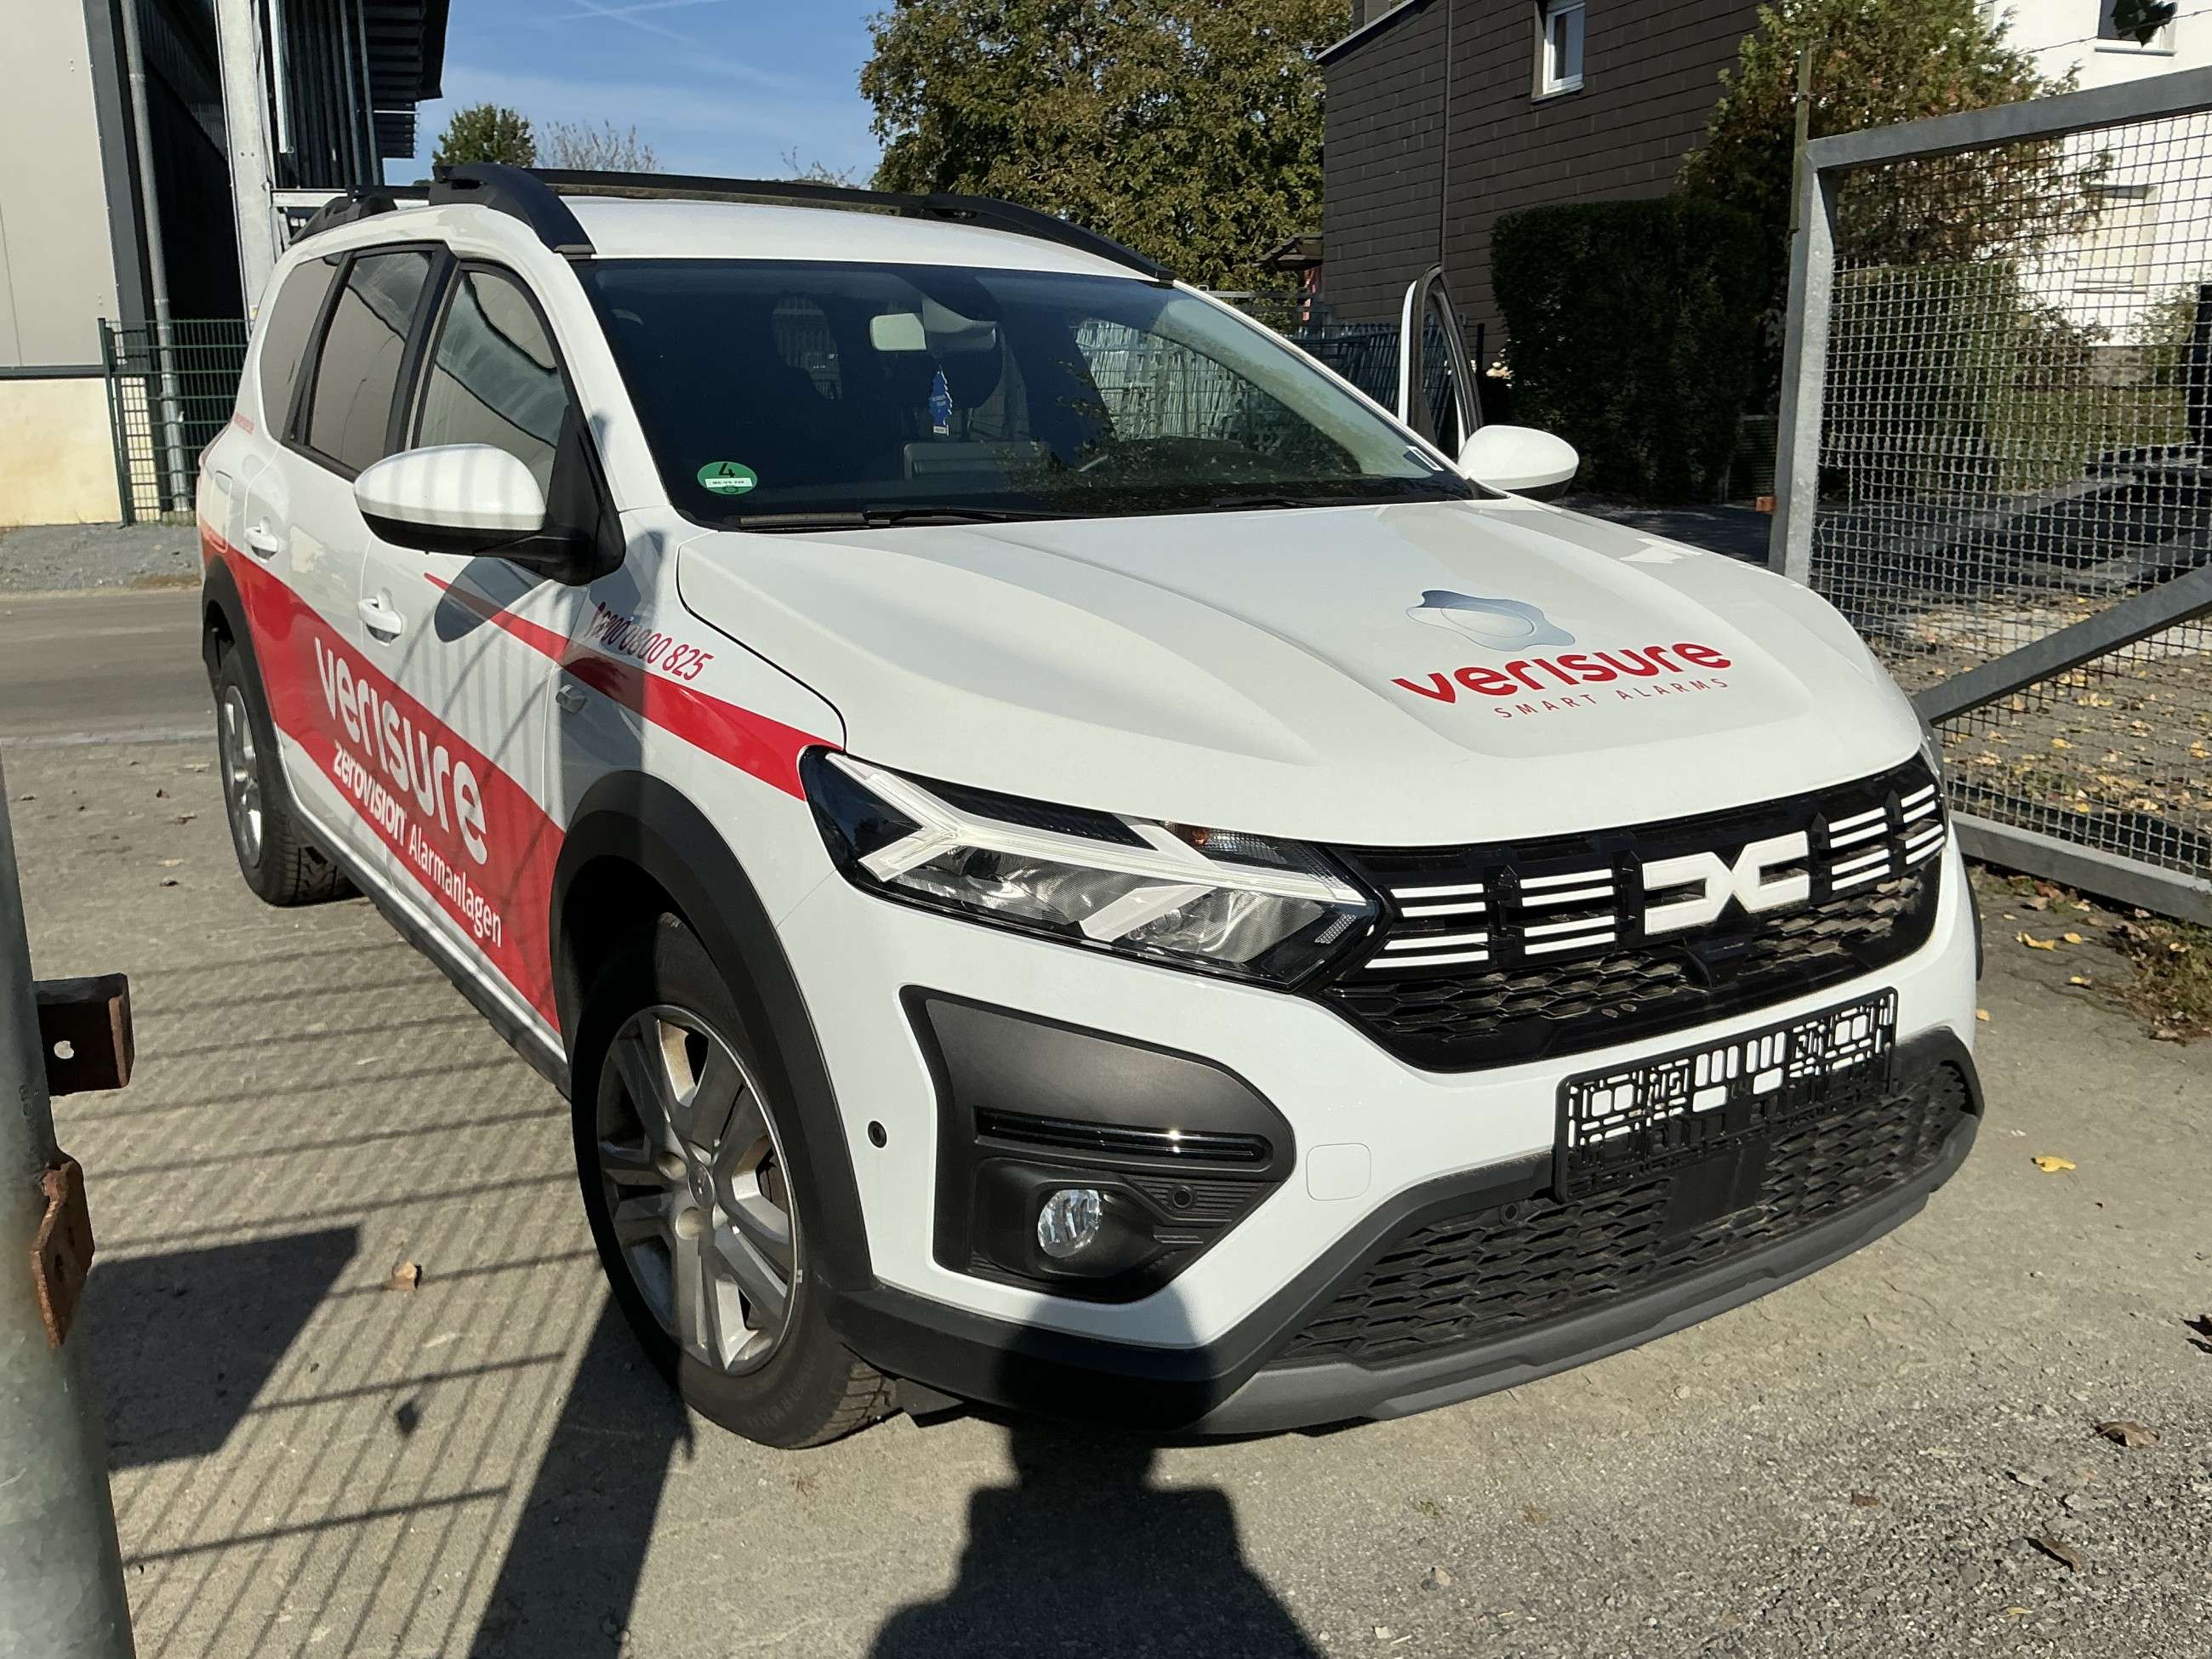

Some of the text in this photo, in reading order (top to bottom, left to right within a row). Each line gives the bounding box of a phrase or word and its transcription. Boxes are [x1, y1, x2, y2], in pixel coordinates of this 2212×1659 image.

[718, 462, 735, 477] 4
[662, 643, 715, 681] 825
[1390, 642, 1732, 704] verisure
[1494, 677, 1728, 718] SMART ALARMS
[314, 636, 487, 864] verisure
[333, 743, 502, 948] zerovision Alarmanlagen
